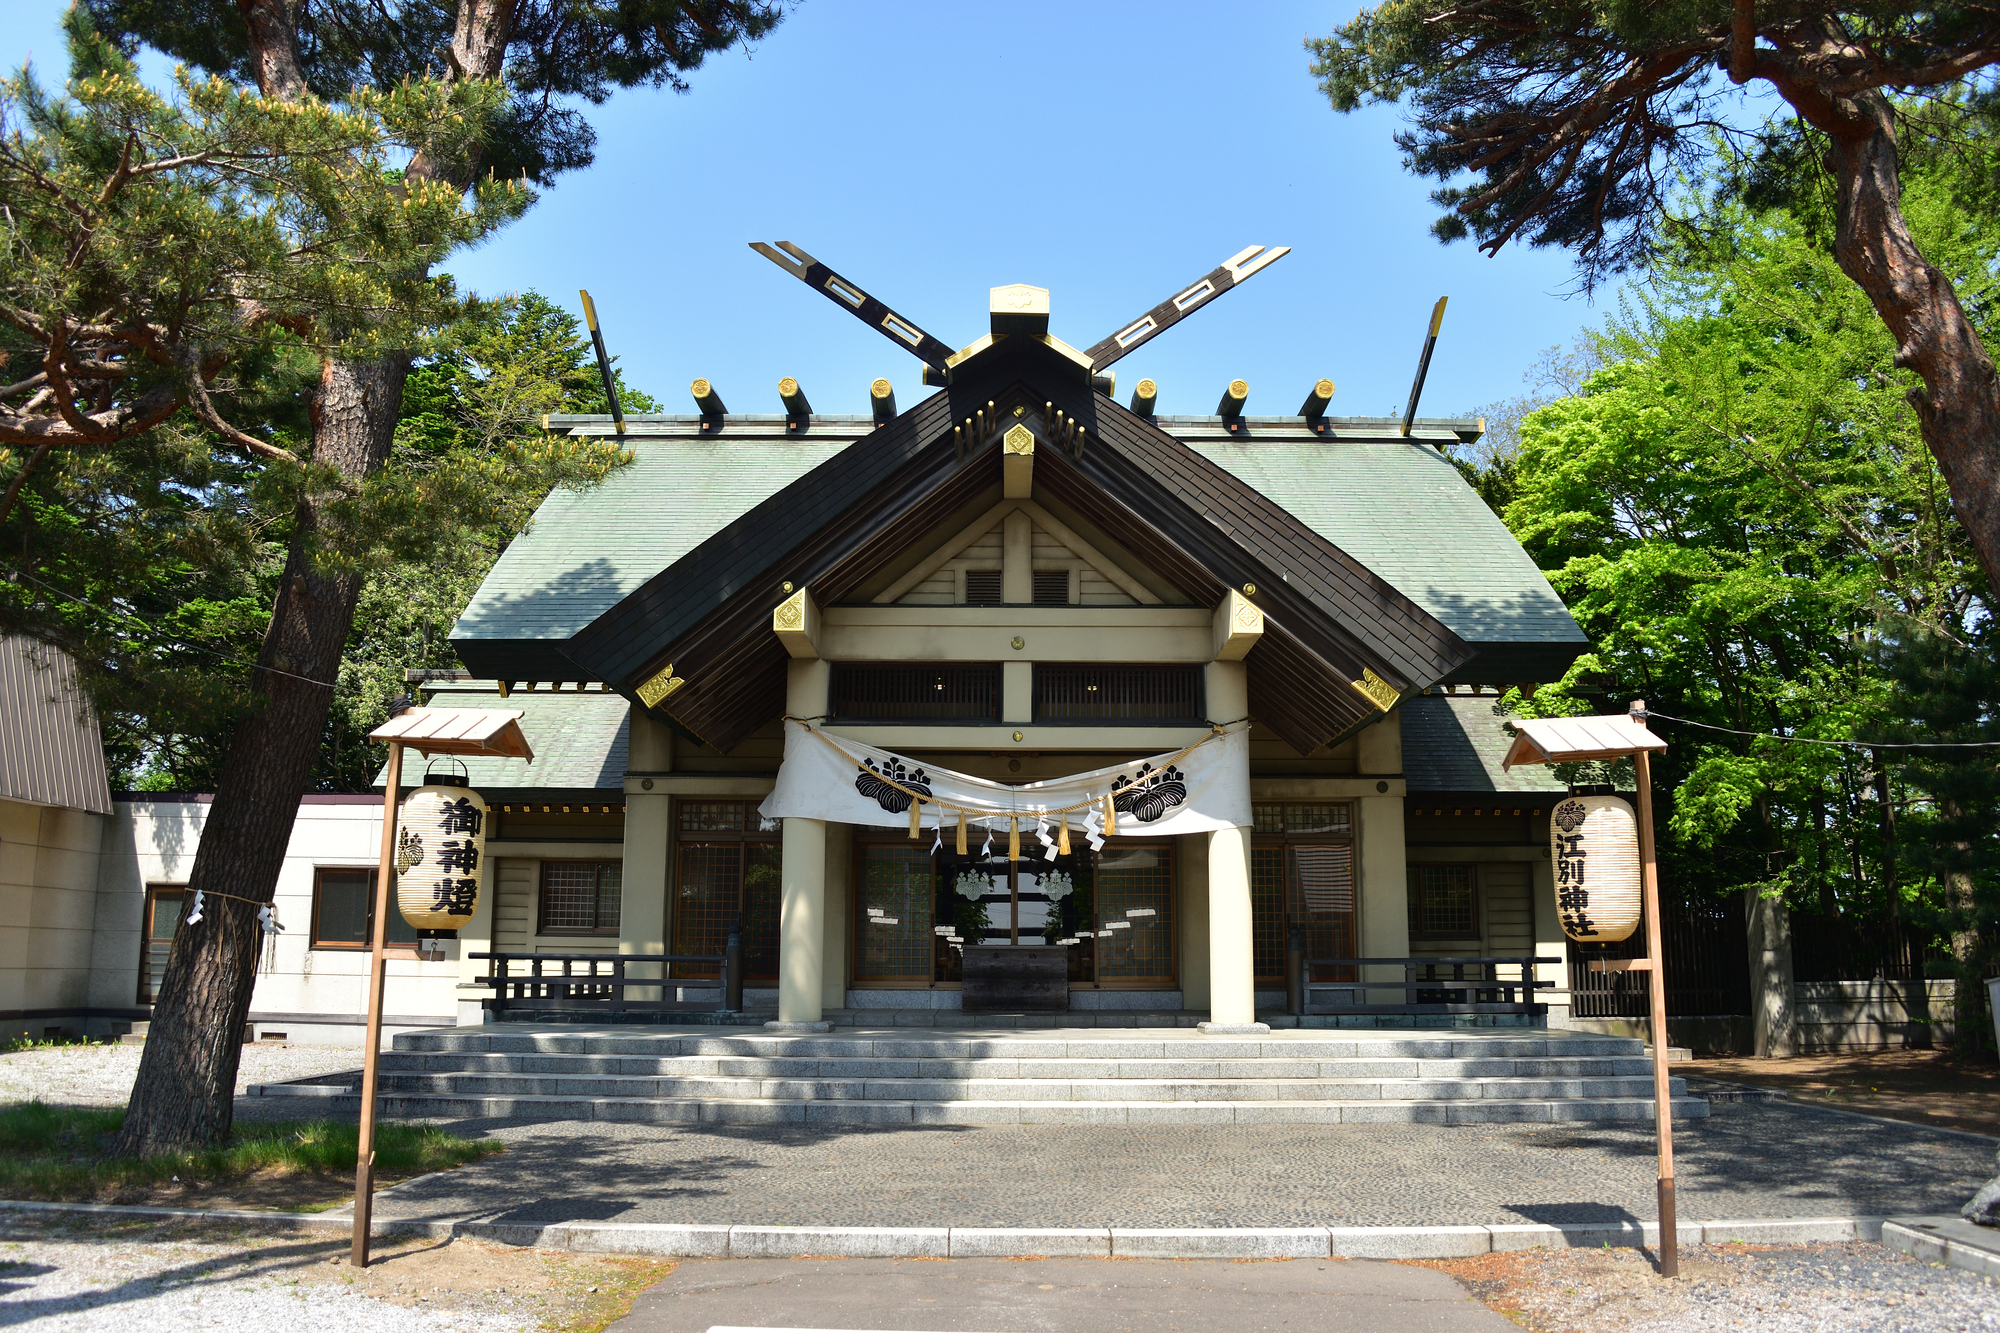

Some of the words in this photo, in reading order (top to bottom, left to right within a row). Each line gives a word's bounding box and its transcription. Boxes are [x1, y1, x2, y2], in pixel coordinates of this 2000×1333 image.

[430, 797, 483, 916] 御神燈
[1556, 833, 1599, 937] 江別神社
